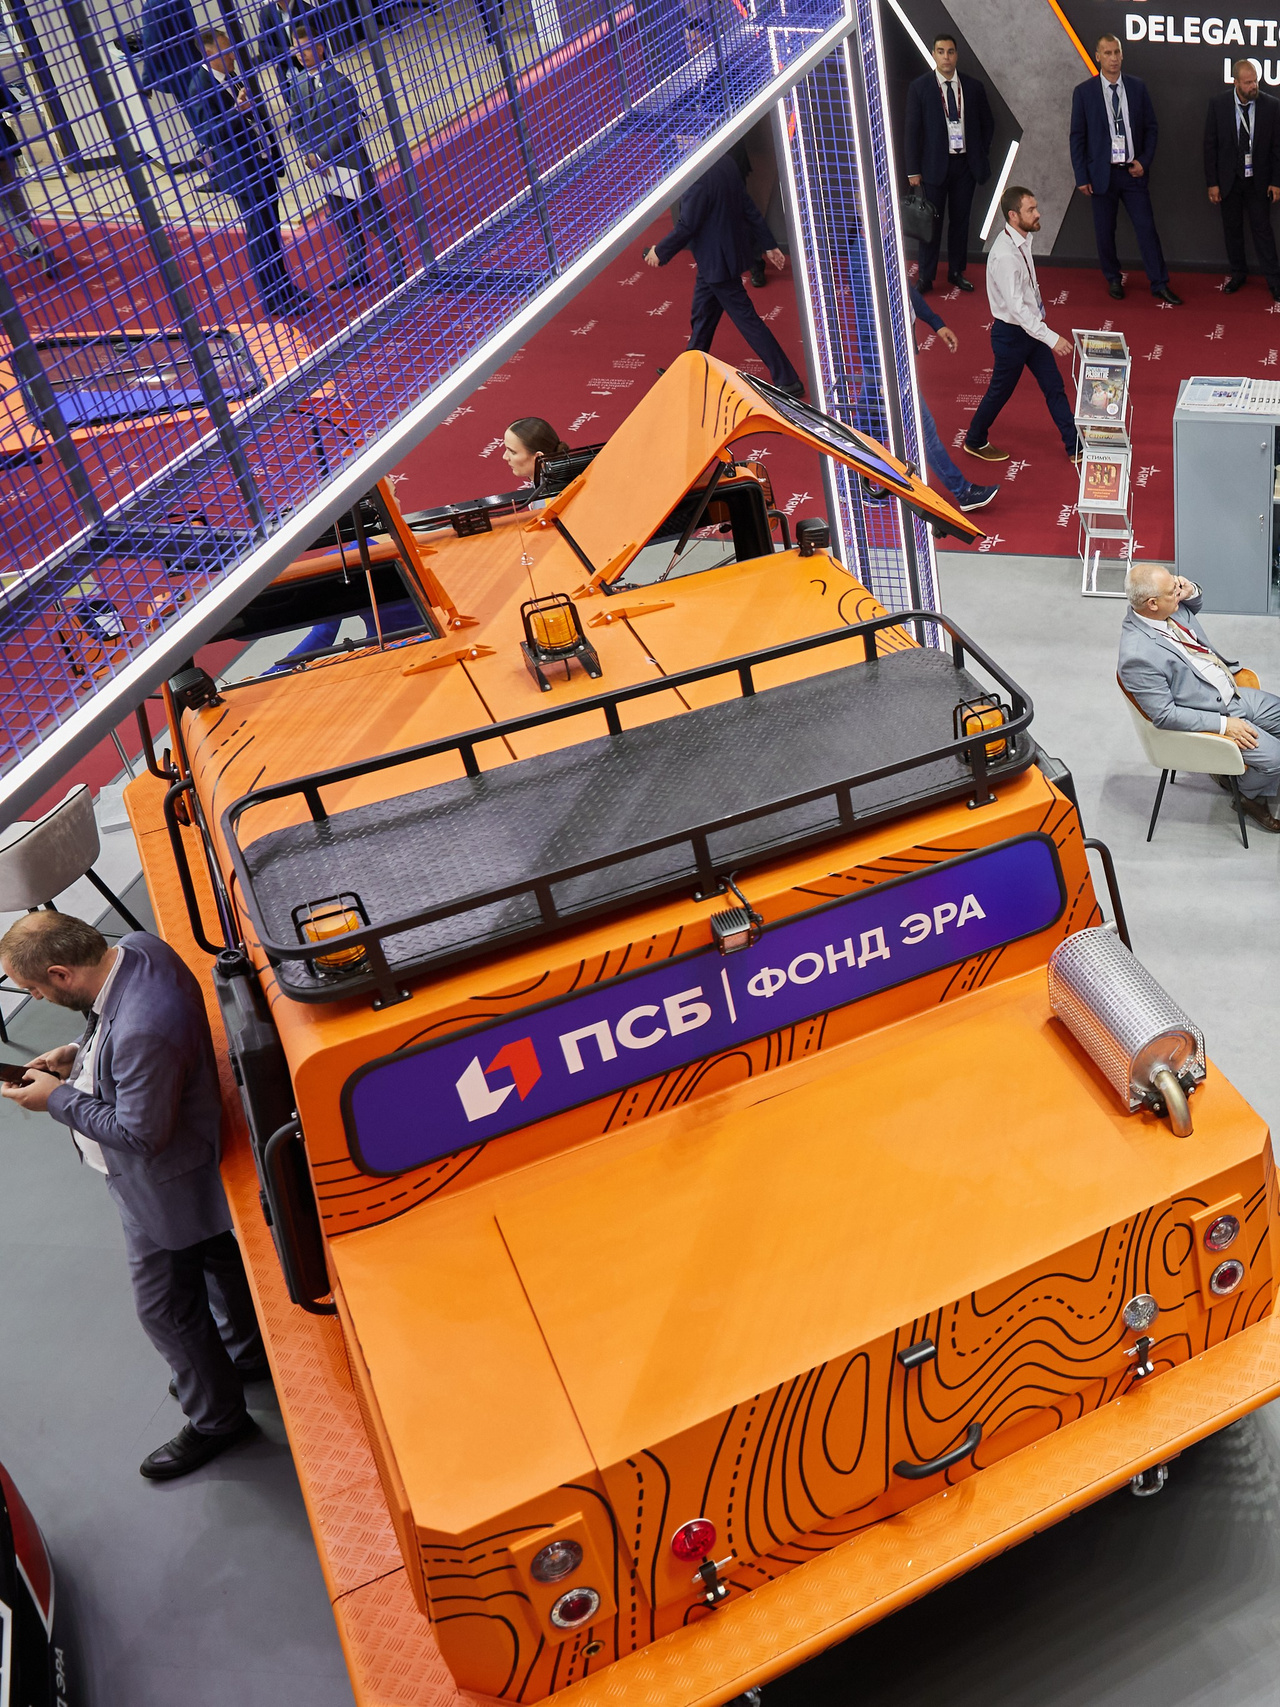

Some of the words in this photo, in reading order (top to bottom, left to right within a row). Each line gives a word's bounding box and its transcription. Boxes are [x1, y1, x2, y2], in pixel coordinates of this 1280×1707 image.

[920, 334, 937, 351] ARMY
[441, 406, 465, 426] ARMY
[568, 411, 594, 432] ARMY
[478, 437, 504, 458] ARMY
[952, 428, 968, 449] ARMY
[1004, 460, 1024, 482] ARMY
[1088, 463, 1117, 486] 30
[783, 492, 805, 516] ARMY
[1056, 503, 1074, 528] ARMY
[558, 986, 713, 1075] ПСБ
[746, 926, 891, 999] ФОНД
[899, 893, 987, 946] ЭРА
[54, 1647, 66, 1694] ЭРА
